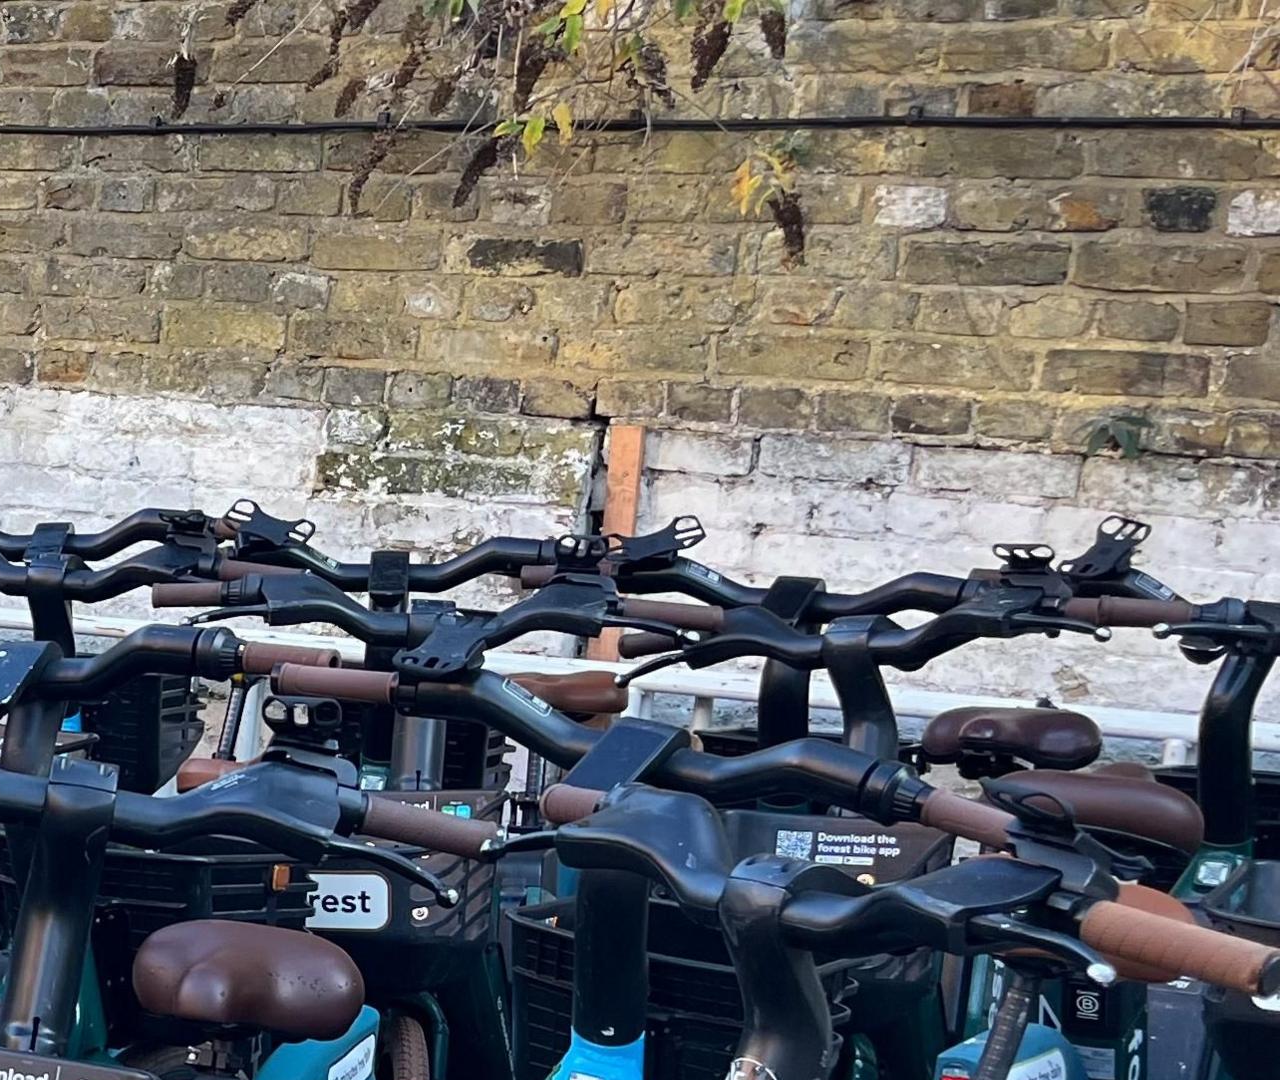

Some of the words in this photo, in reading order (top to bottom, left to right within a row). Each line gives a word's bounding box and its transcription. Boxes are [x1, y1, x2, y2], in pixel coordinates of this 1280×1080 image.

[817, 831, 876, 845] Download
[877, 833, 897, 845] the
[816, 843, 851, 854] forest
[851, 844, 877, 855] bike
[878, 847, 901, 858] app
